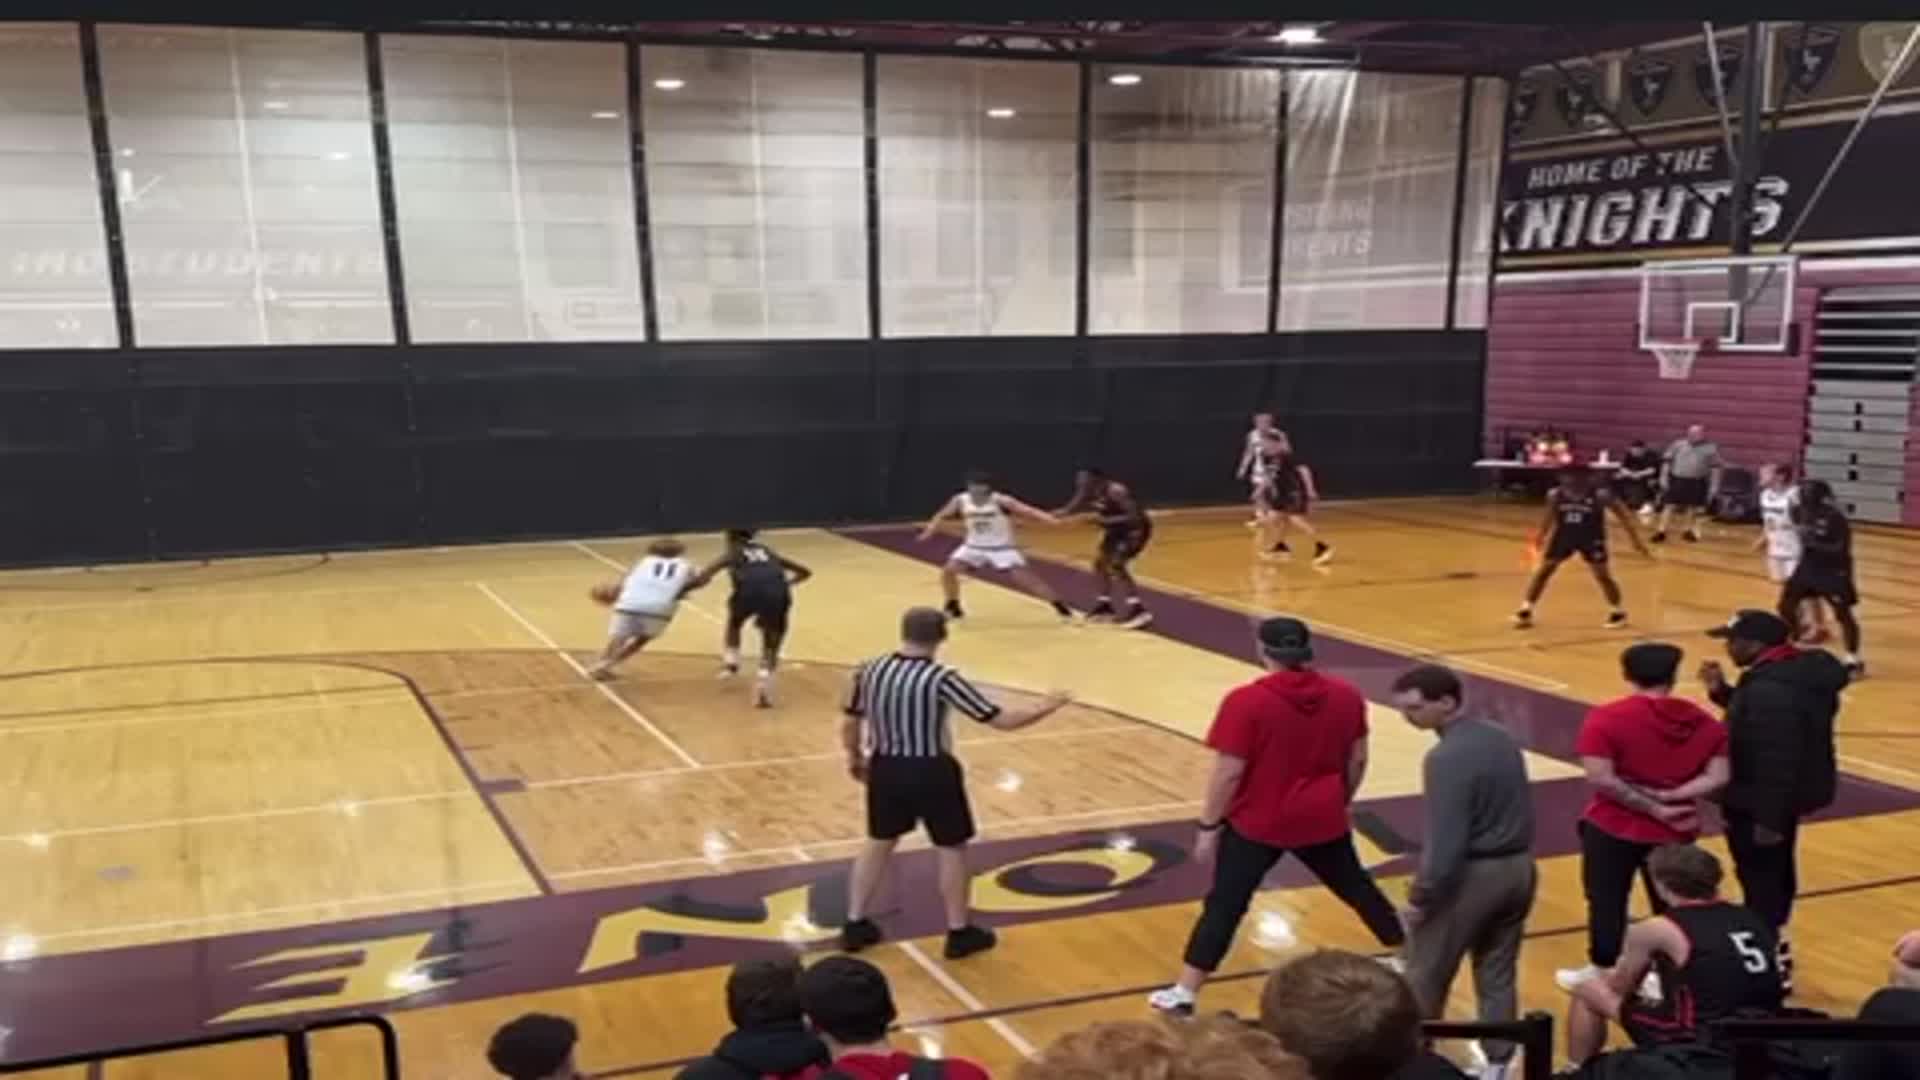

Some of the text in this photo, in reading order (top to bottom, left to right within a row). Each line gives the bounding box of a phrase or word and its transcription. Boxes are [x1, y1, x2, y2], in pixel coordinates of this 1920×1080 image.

[1526, 146, 1717, 190] HOME OF THE
[1728, 932, 1769, 973] 5
